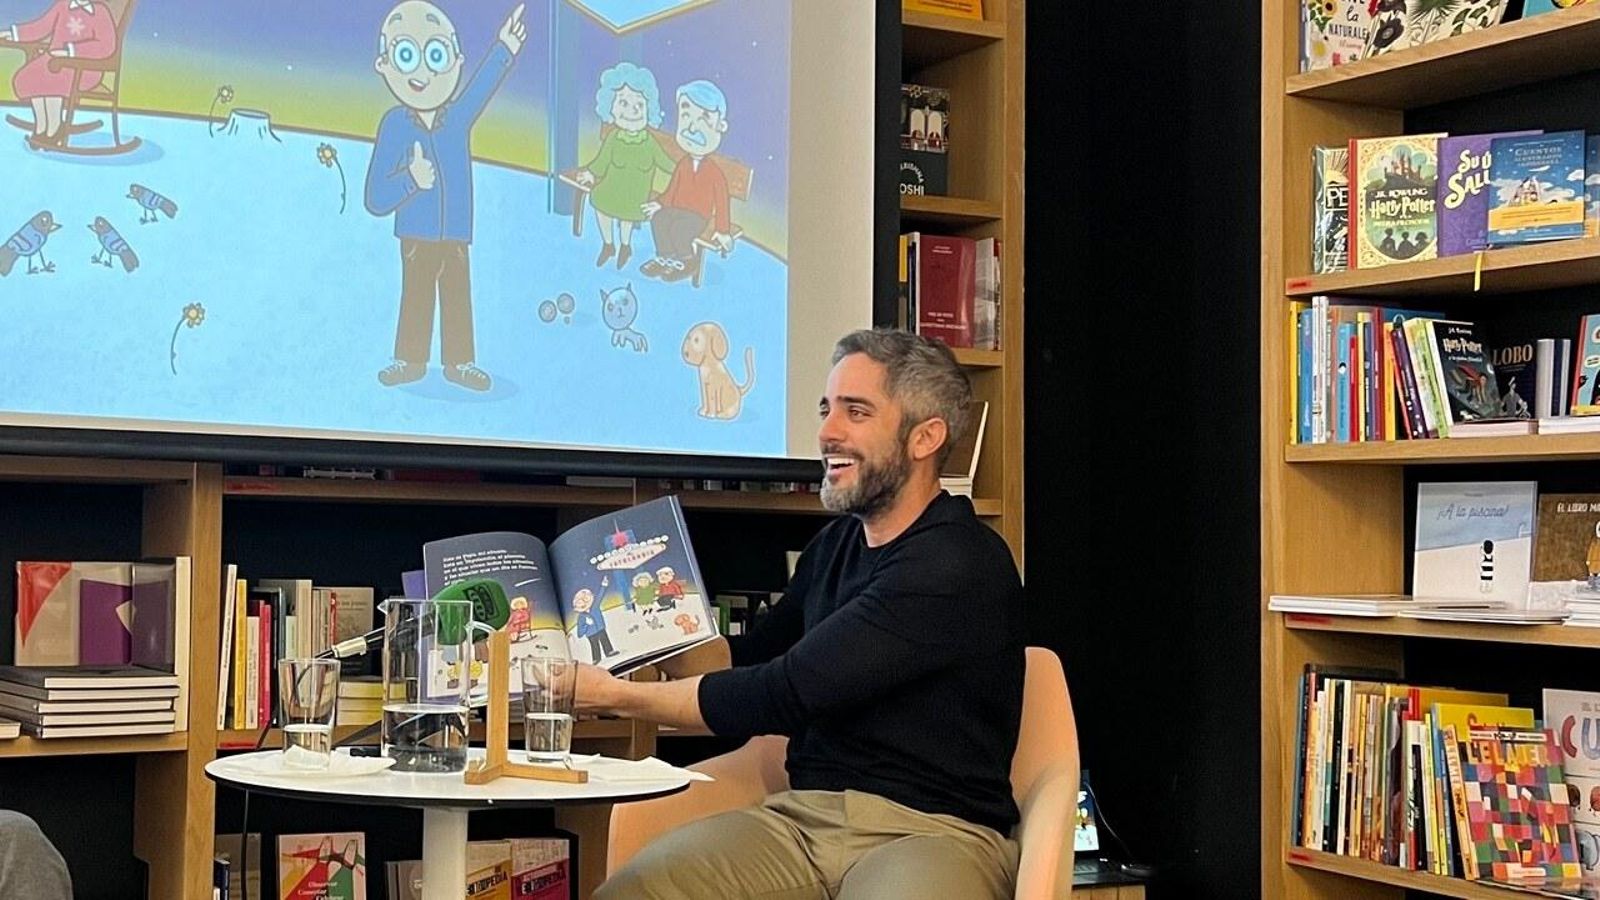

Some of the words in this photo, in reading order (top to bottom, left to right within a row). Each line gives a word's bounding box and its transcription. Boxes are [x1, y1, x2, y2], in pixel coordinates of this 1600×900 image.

[1346, 5, 1359, 21] la
[1369, 200, 1402, 219] Harry
[1401, 196, 1436, 218] Potter
[1493, 344, 1533, 366] LOBO
